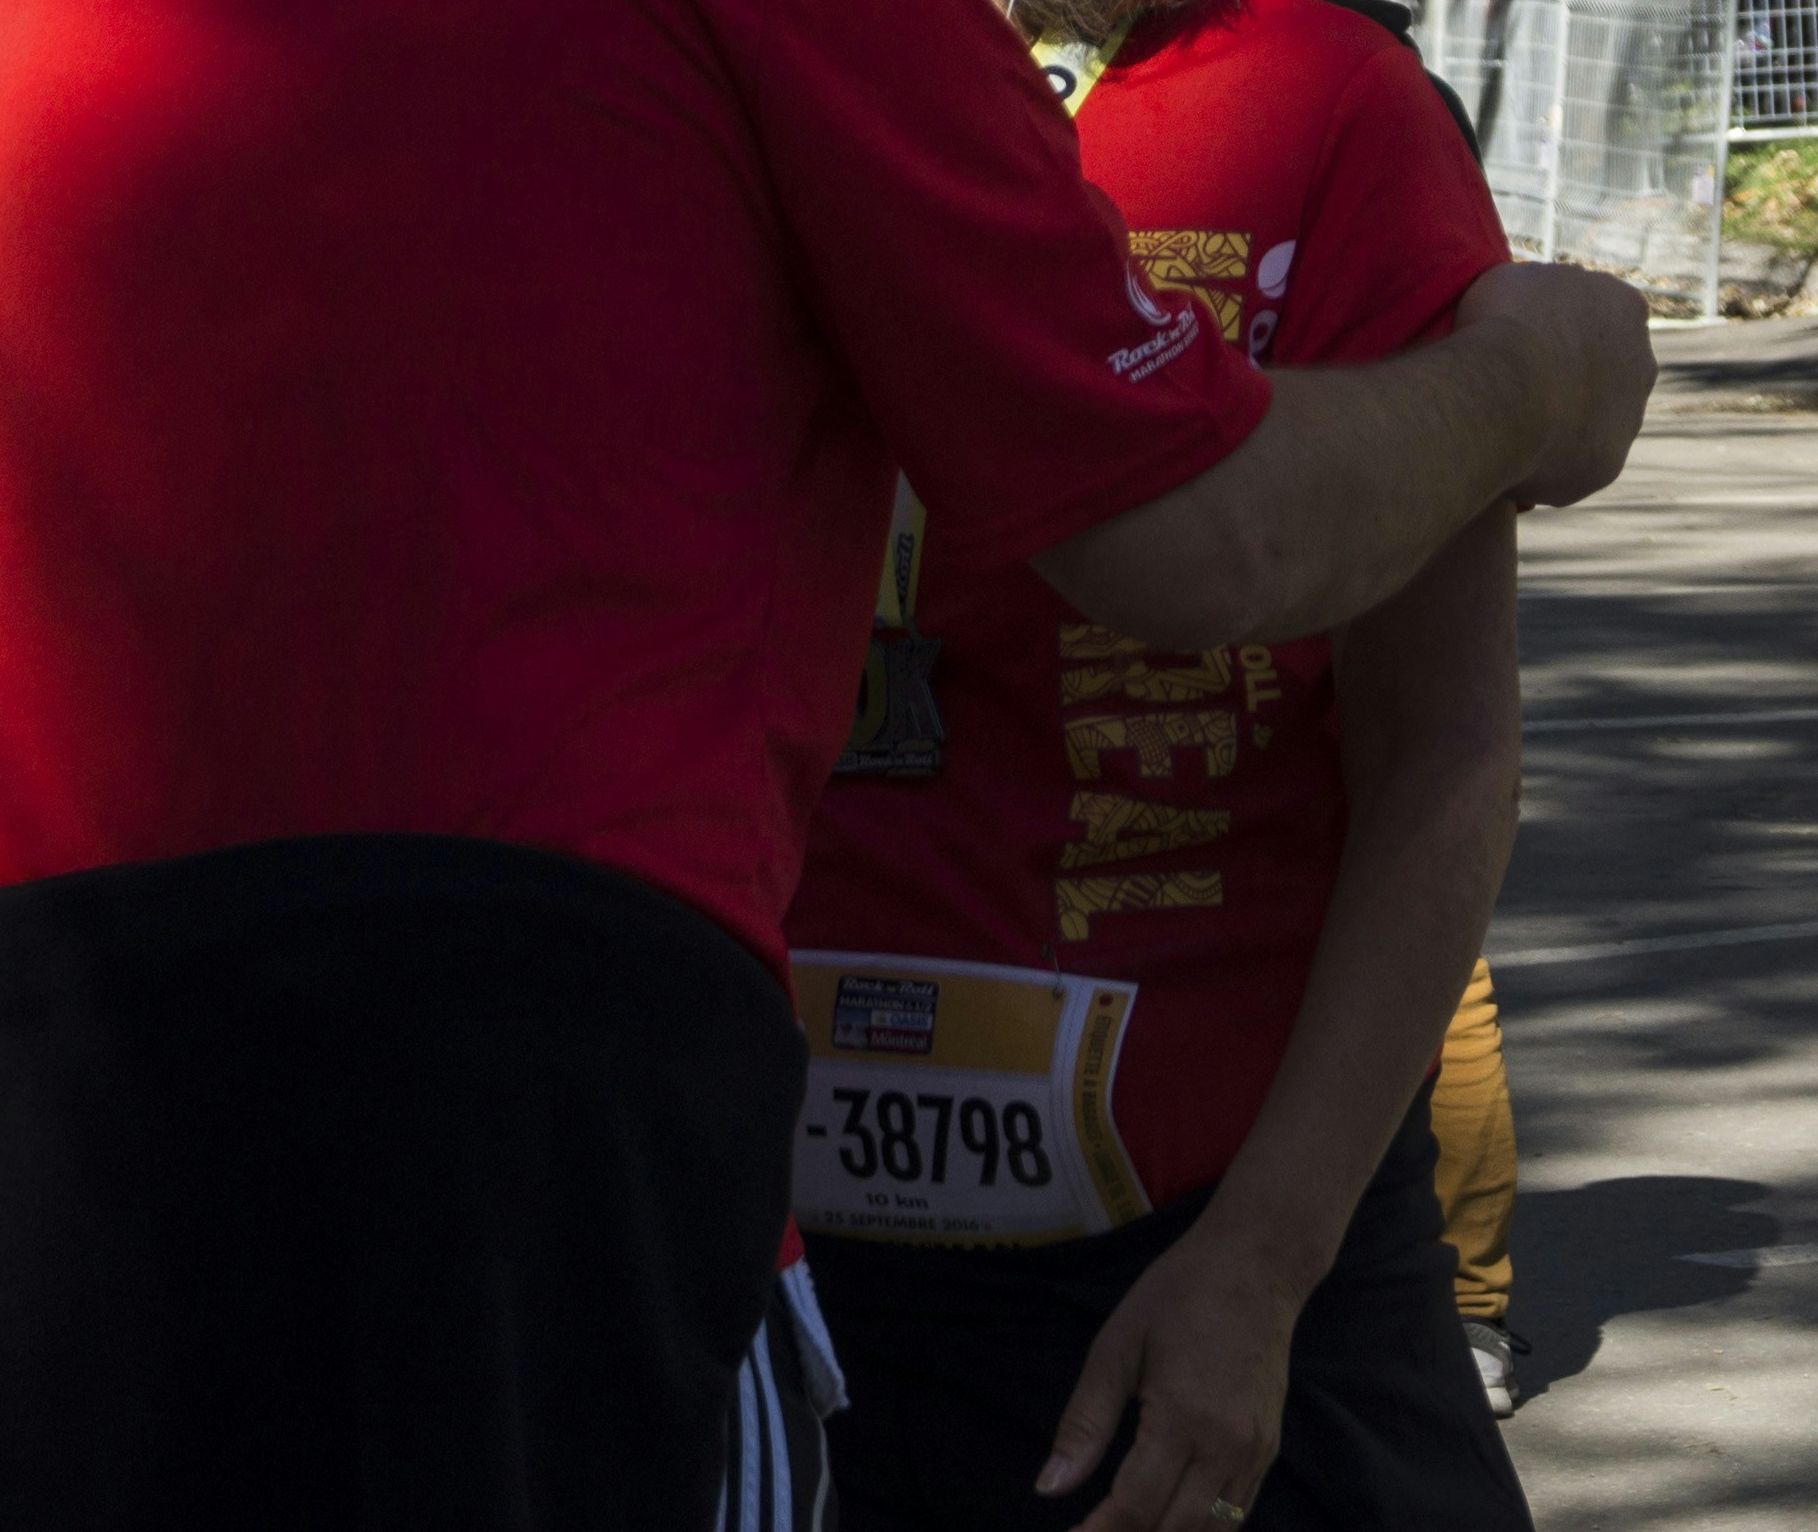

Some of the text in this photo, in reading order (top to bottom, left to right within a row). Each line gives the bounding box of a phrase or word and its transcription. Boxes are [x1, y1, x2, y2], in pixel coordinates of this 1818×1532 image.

[1106, 330, 1167, 376] Rock
[839, 995, 904, 1010] MARATHON
[890, 1013, 929, 1026] OASIS
[807, 1085, 1053, 1188] -38798
[866, 1192, 929, 1210] 10 km
[824, 1210, 980, 1232] 25 SEPTEMBRE 2016
